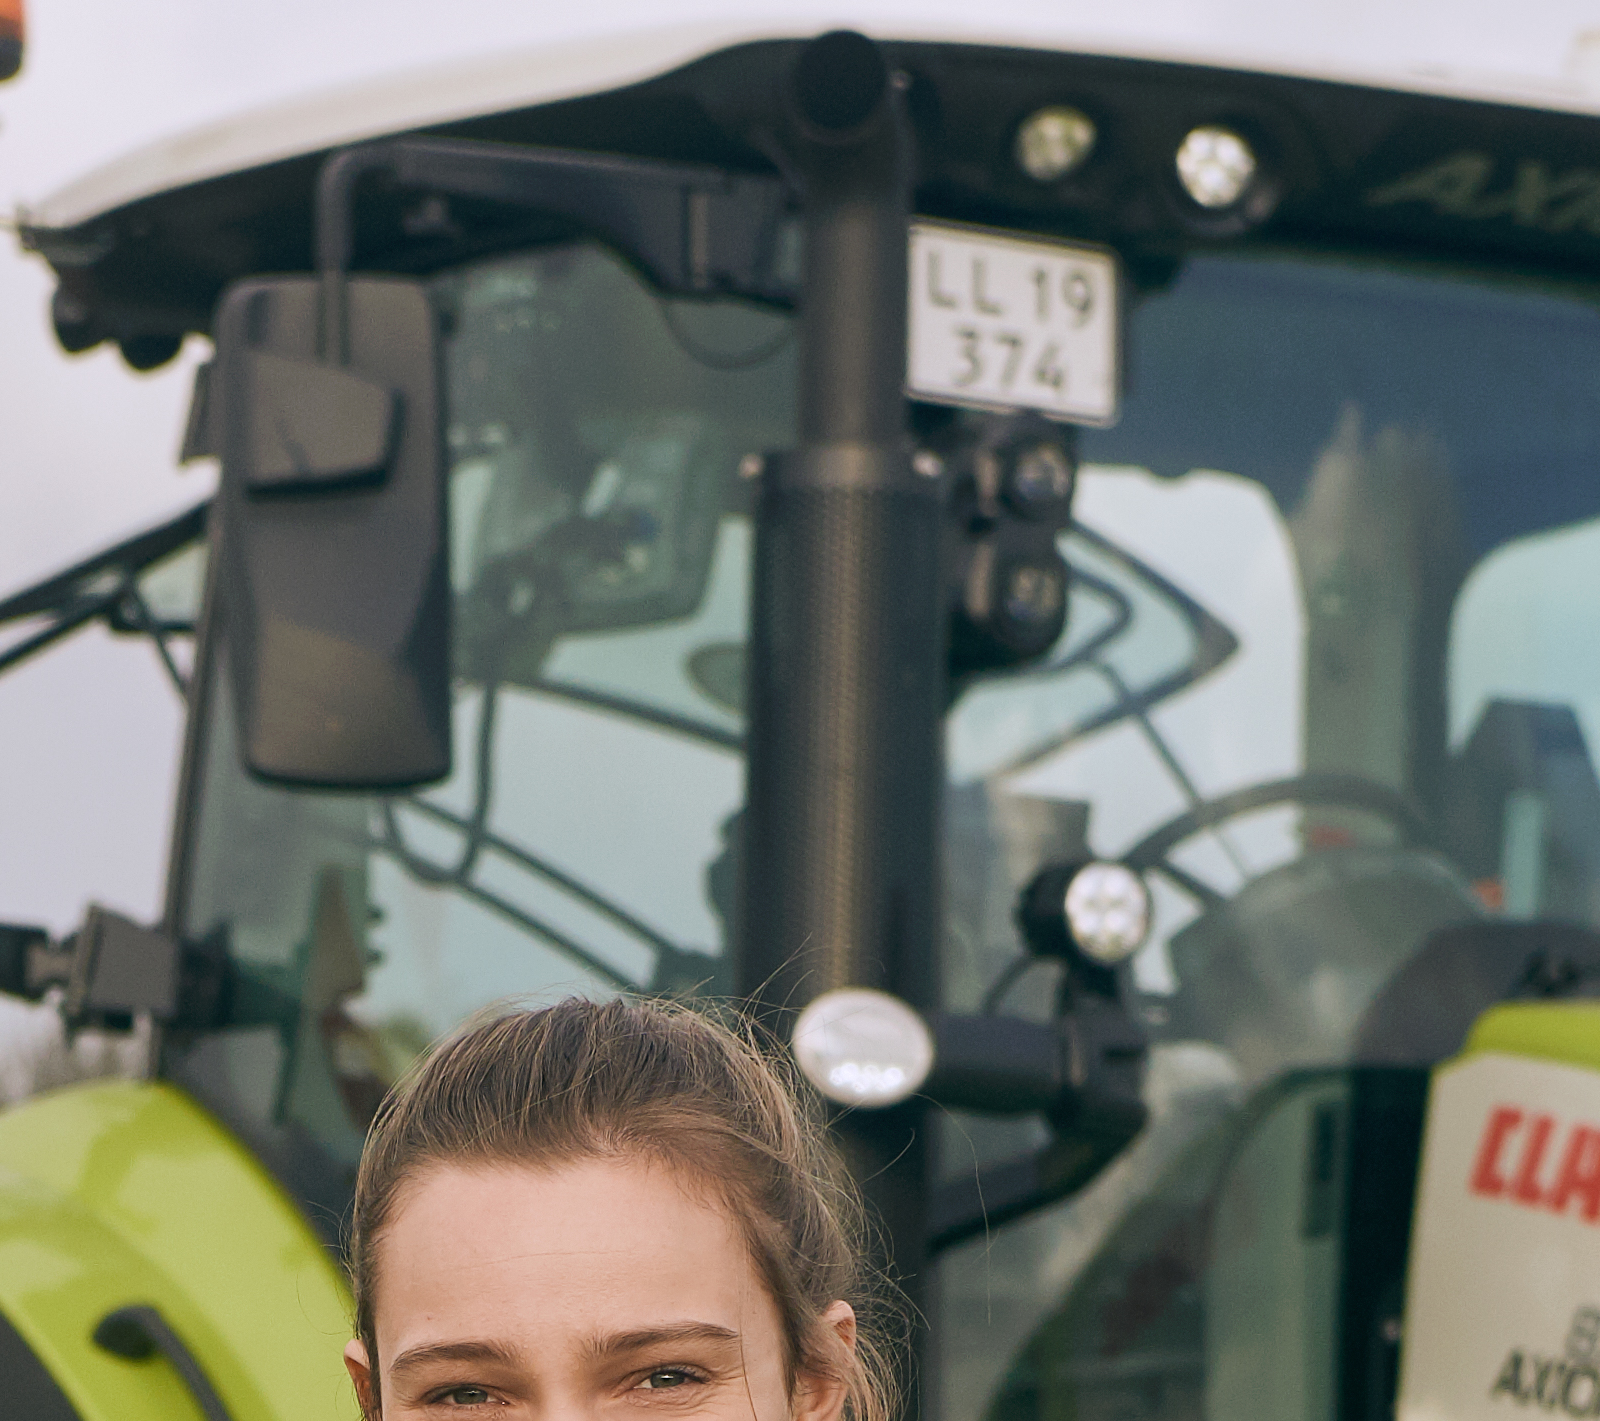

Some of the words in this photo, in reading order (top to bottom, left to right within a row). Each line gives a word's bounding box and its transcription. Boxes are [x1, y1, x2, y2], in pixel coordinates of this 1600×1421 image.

[927, 249, 1004, 316] LL
[1032, 266, 1093, 329] 19
[955, 325, 1064, 391] 374
